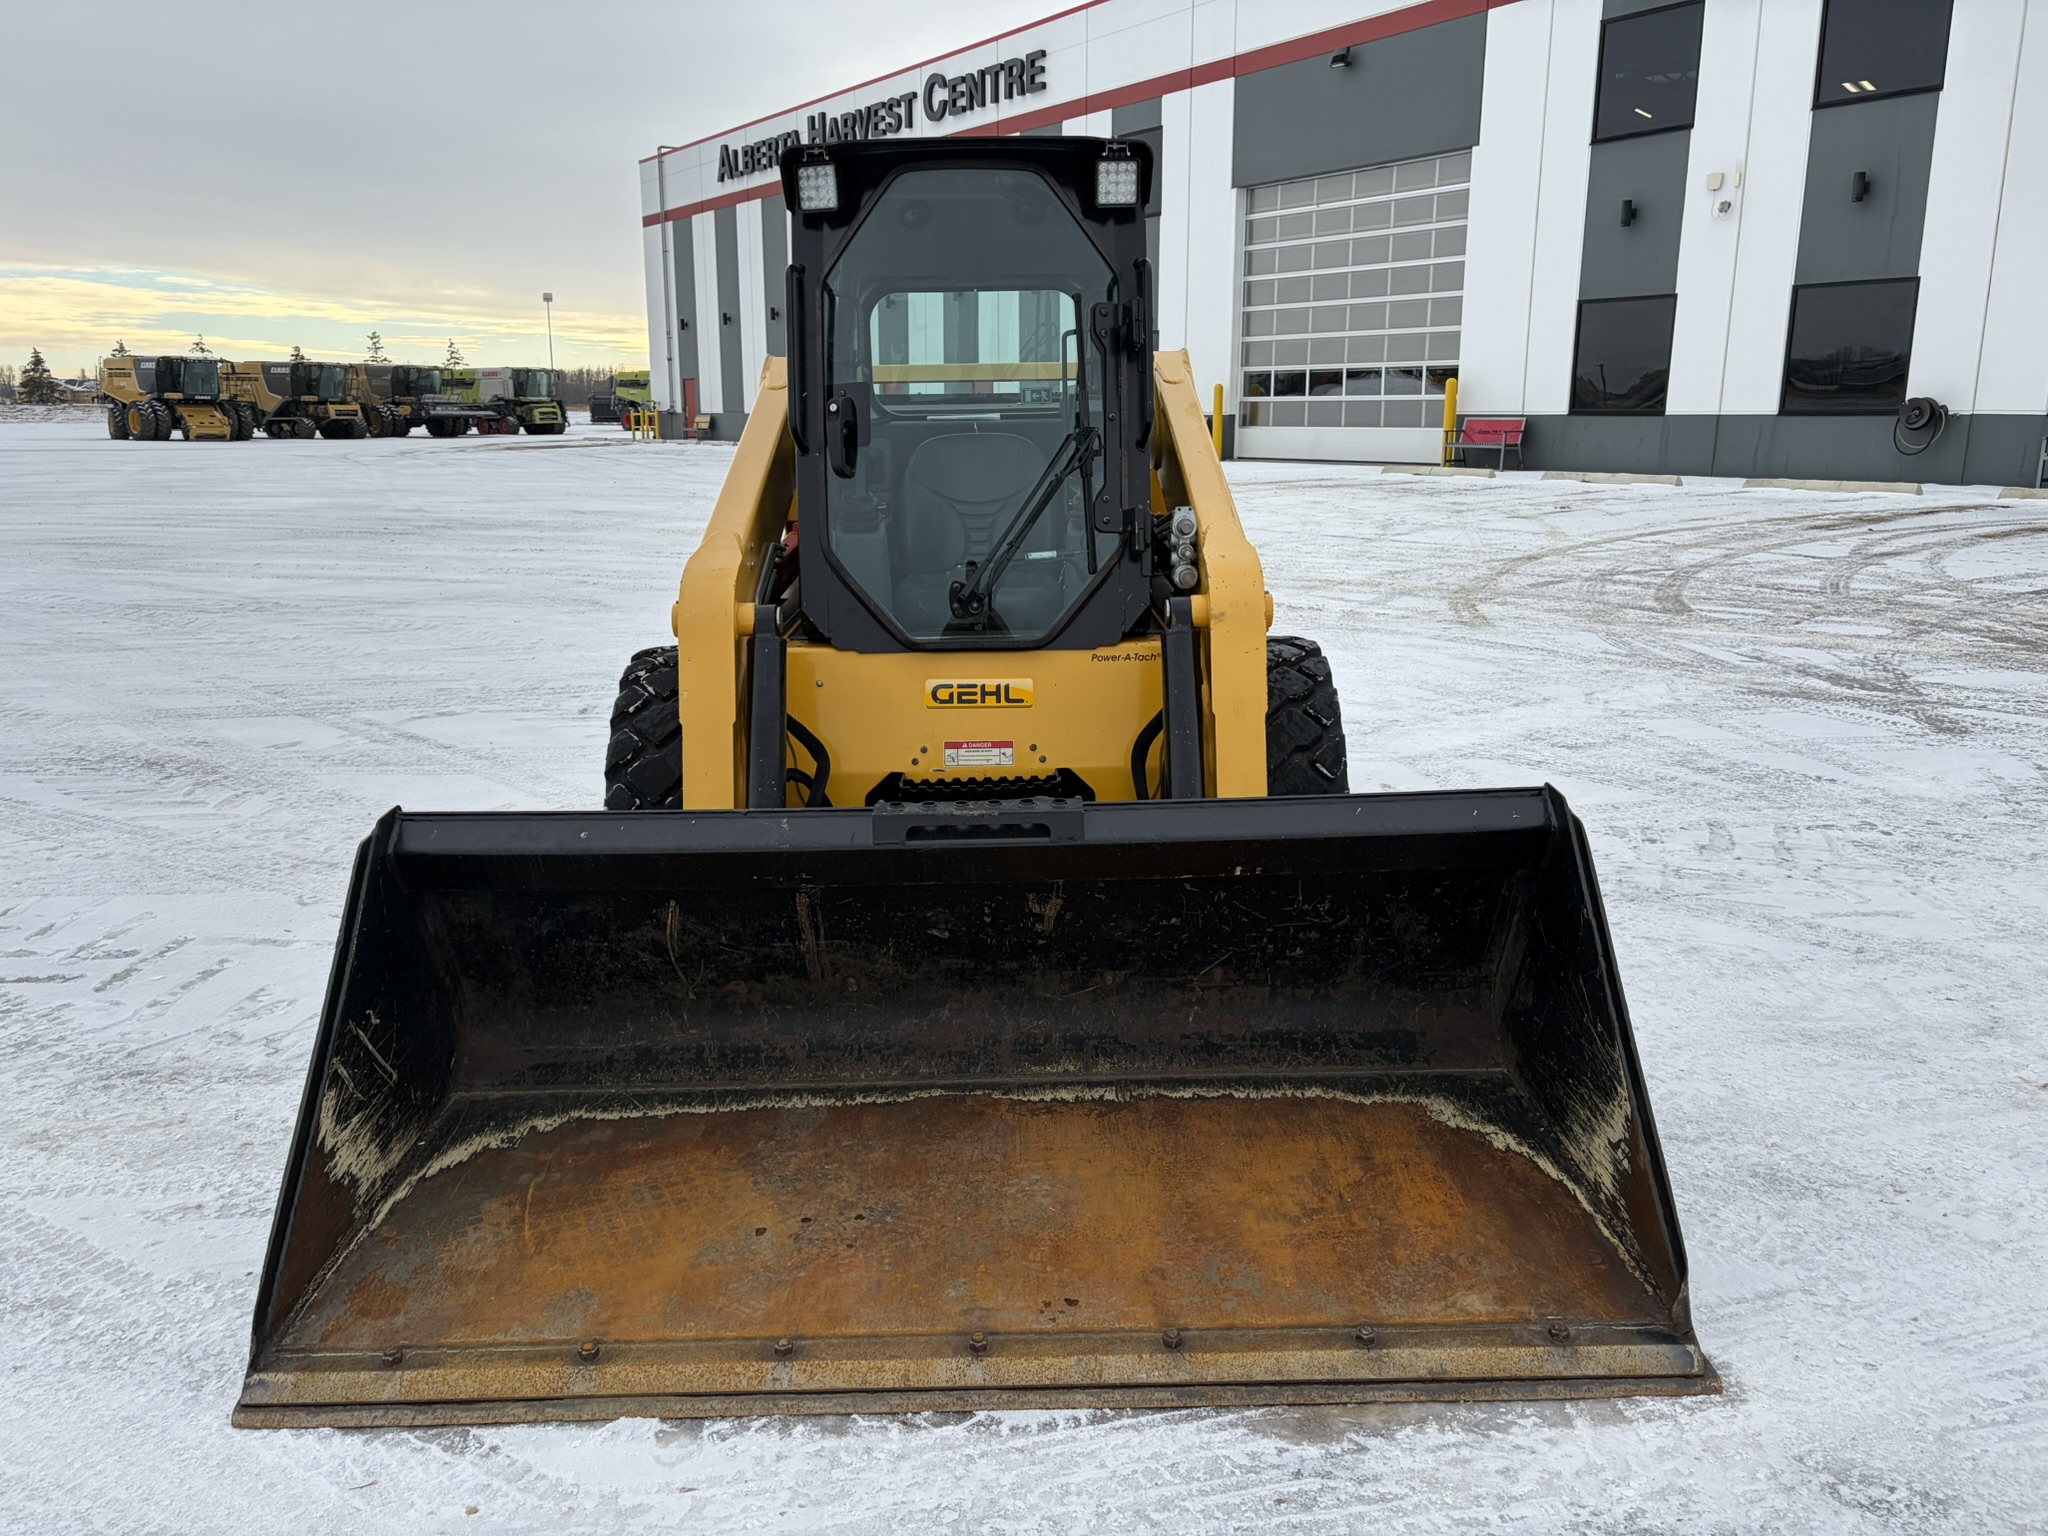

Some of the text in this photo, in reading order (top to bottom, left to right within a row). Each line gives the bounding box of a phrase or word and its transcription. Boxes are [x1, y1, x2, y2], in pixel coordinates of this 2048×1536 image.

[807, 91, 918, 144] HARVEST
[923, 49, 1047, 122] CENTRE
[931, 683, 1025, 704] GEHL
